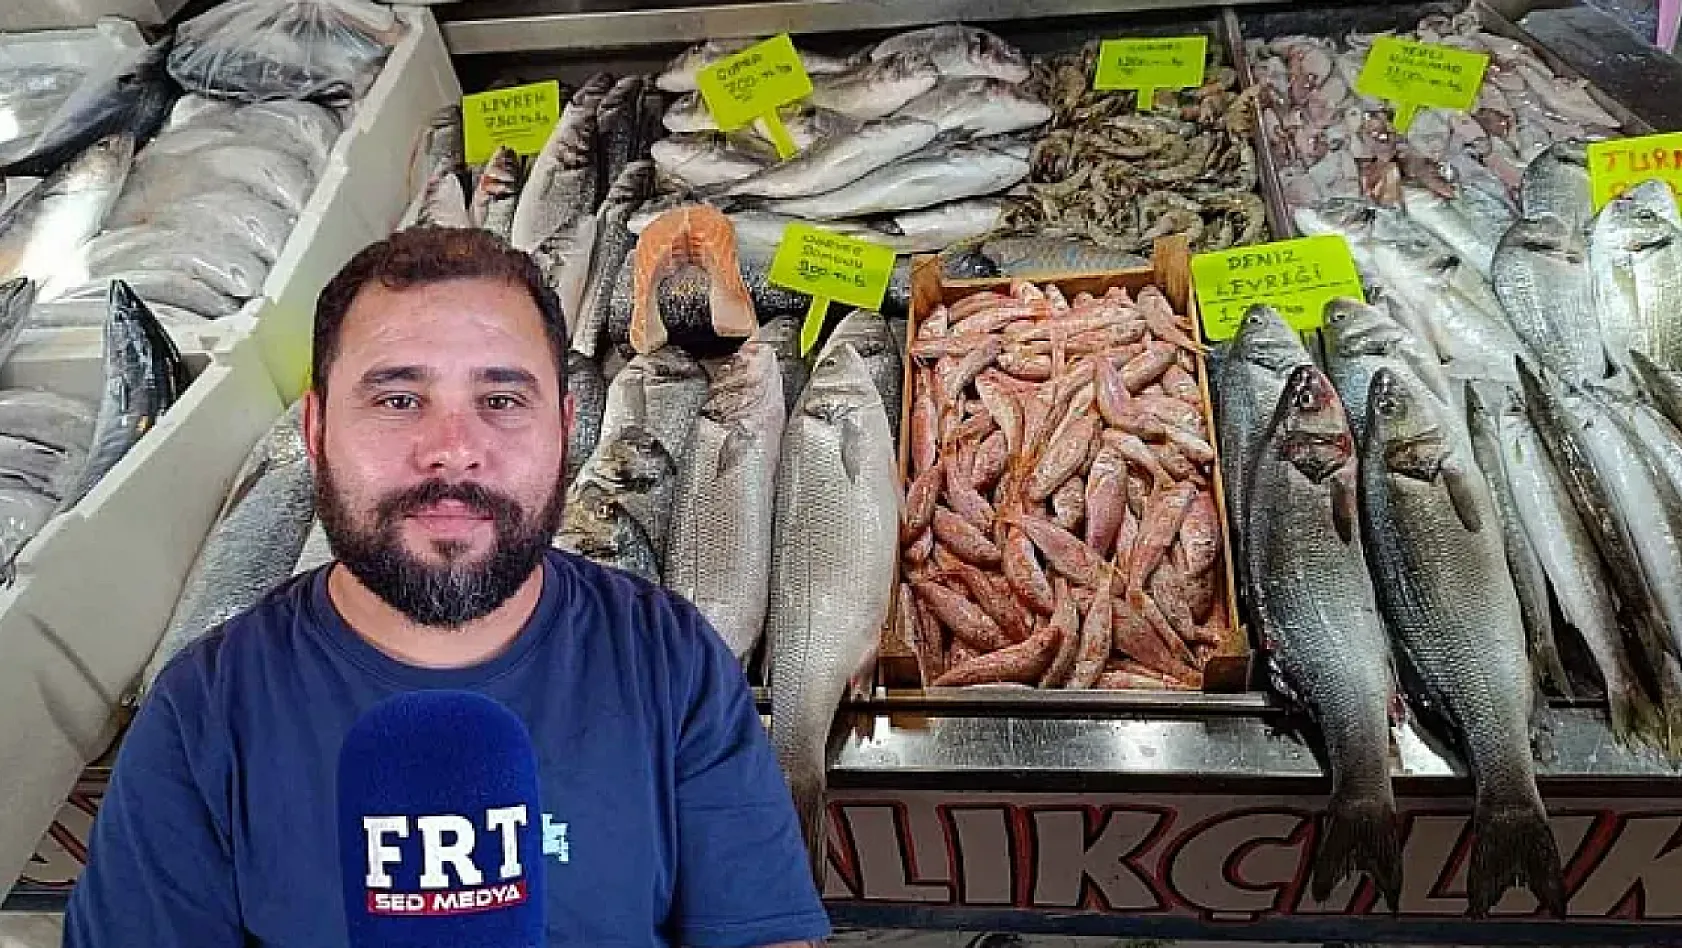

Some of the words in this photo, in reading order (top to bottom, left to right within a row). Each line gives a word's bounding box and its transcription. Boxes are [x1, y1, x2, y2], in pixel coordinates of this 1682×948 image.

[363, 804, 527, 888] FRT
[375, 893, 425, 910] SED
[433, 884, 520, 911] MEDYA
